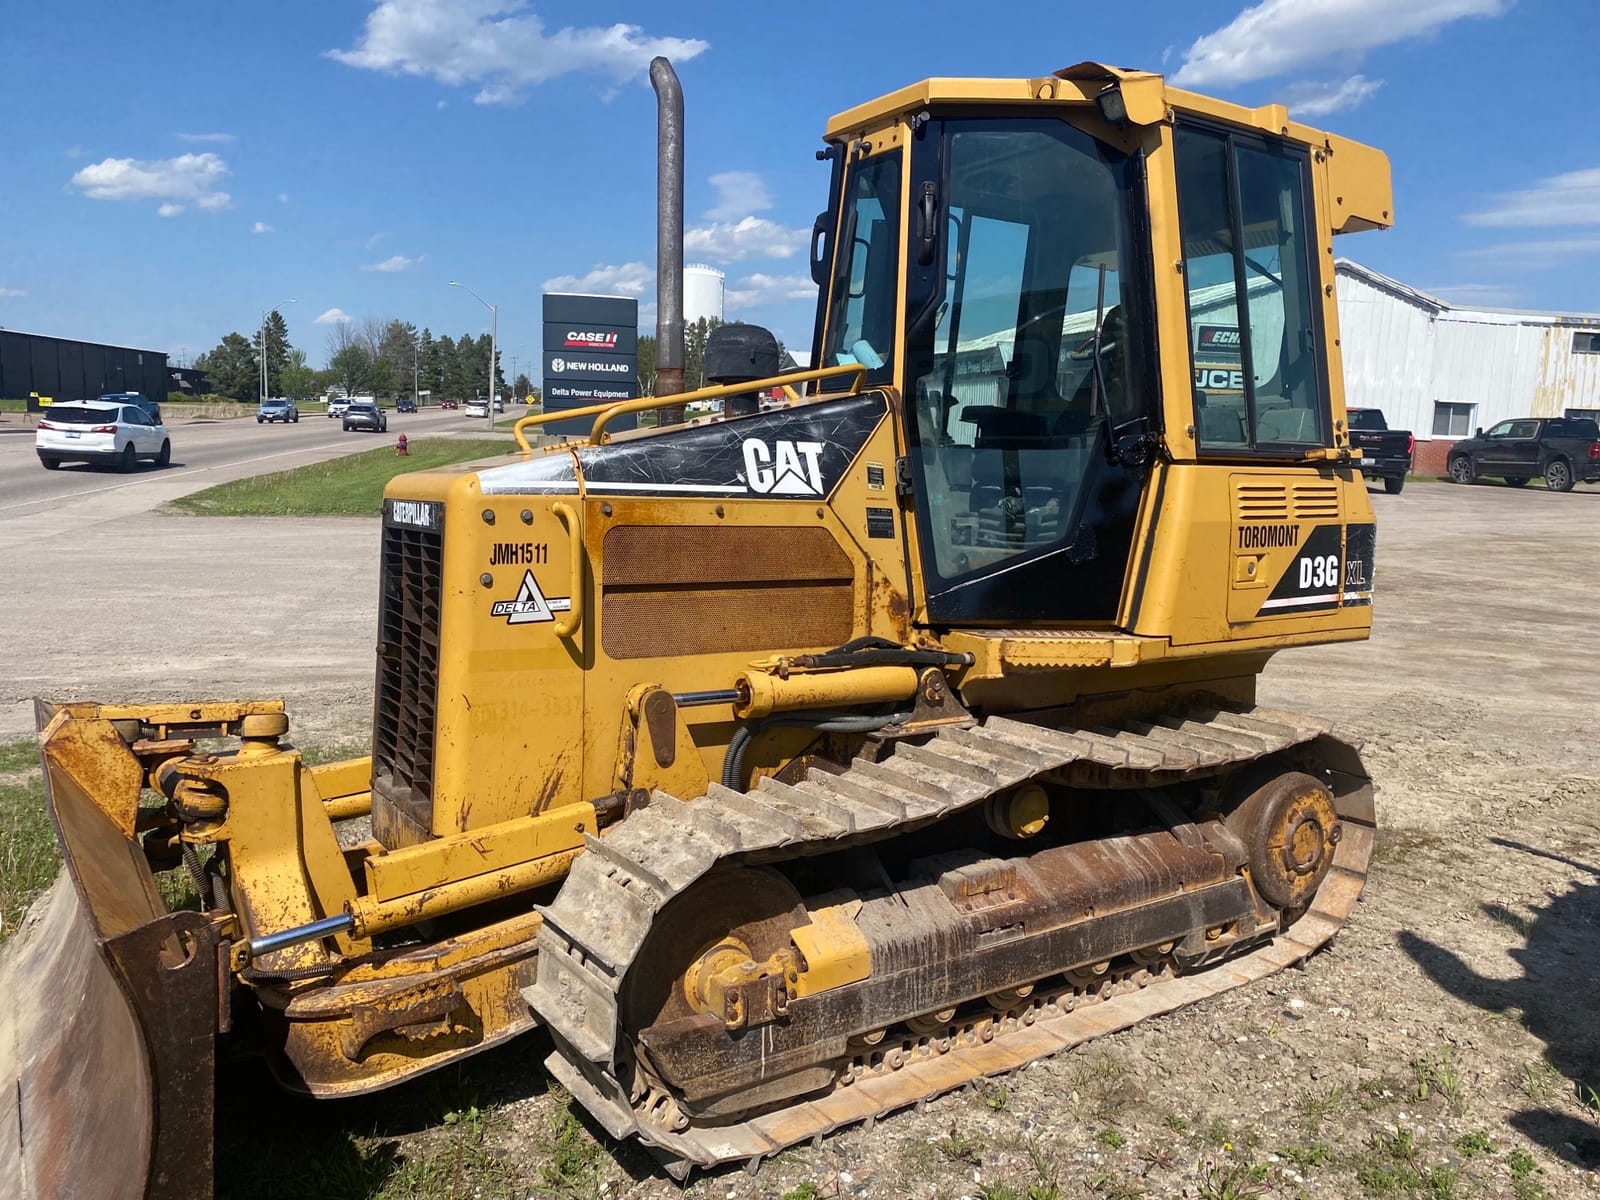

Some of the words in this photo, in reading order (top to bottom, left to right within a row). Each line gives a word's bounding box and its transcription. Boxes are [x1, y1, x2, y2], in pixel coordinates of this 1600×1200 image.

[567, 331, 605, 342] CASE
[567, 362, 587, 371] NEW
[588, 363, 629, 372] HOLLAND
[552, 388, 570, 396] Delta
[571, 389, 592, 397] Power
[594, 389, 629, 399] Equipment
[742, 437, 824, 495] CAT
[393, 501, 430, 527] CATERPILLAR
[1238, 524, 1300, 549] TOROMONT
[490, 543, 548, 566] JMH1511
[1299, 555, 1339, 589] D3G
[1345, 560, 1366, 585] XL
[495, 602, 536, 614] DELTA
